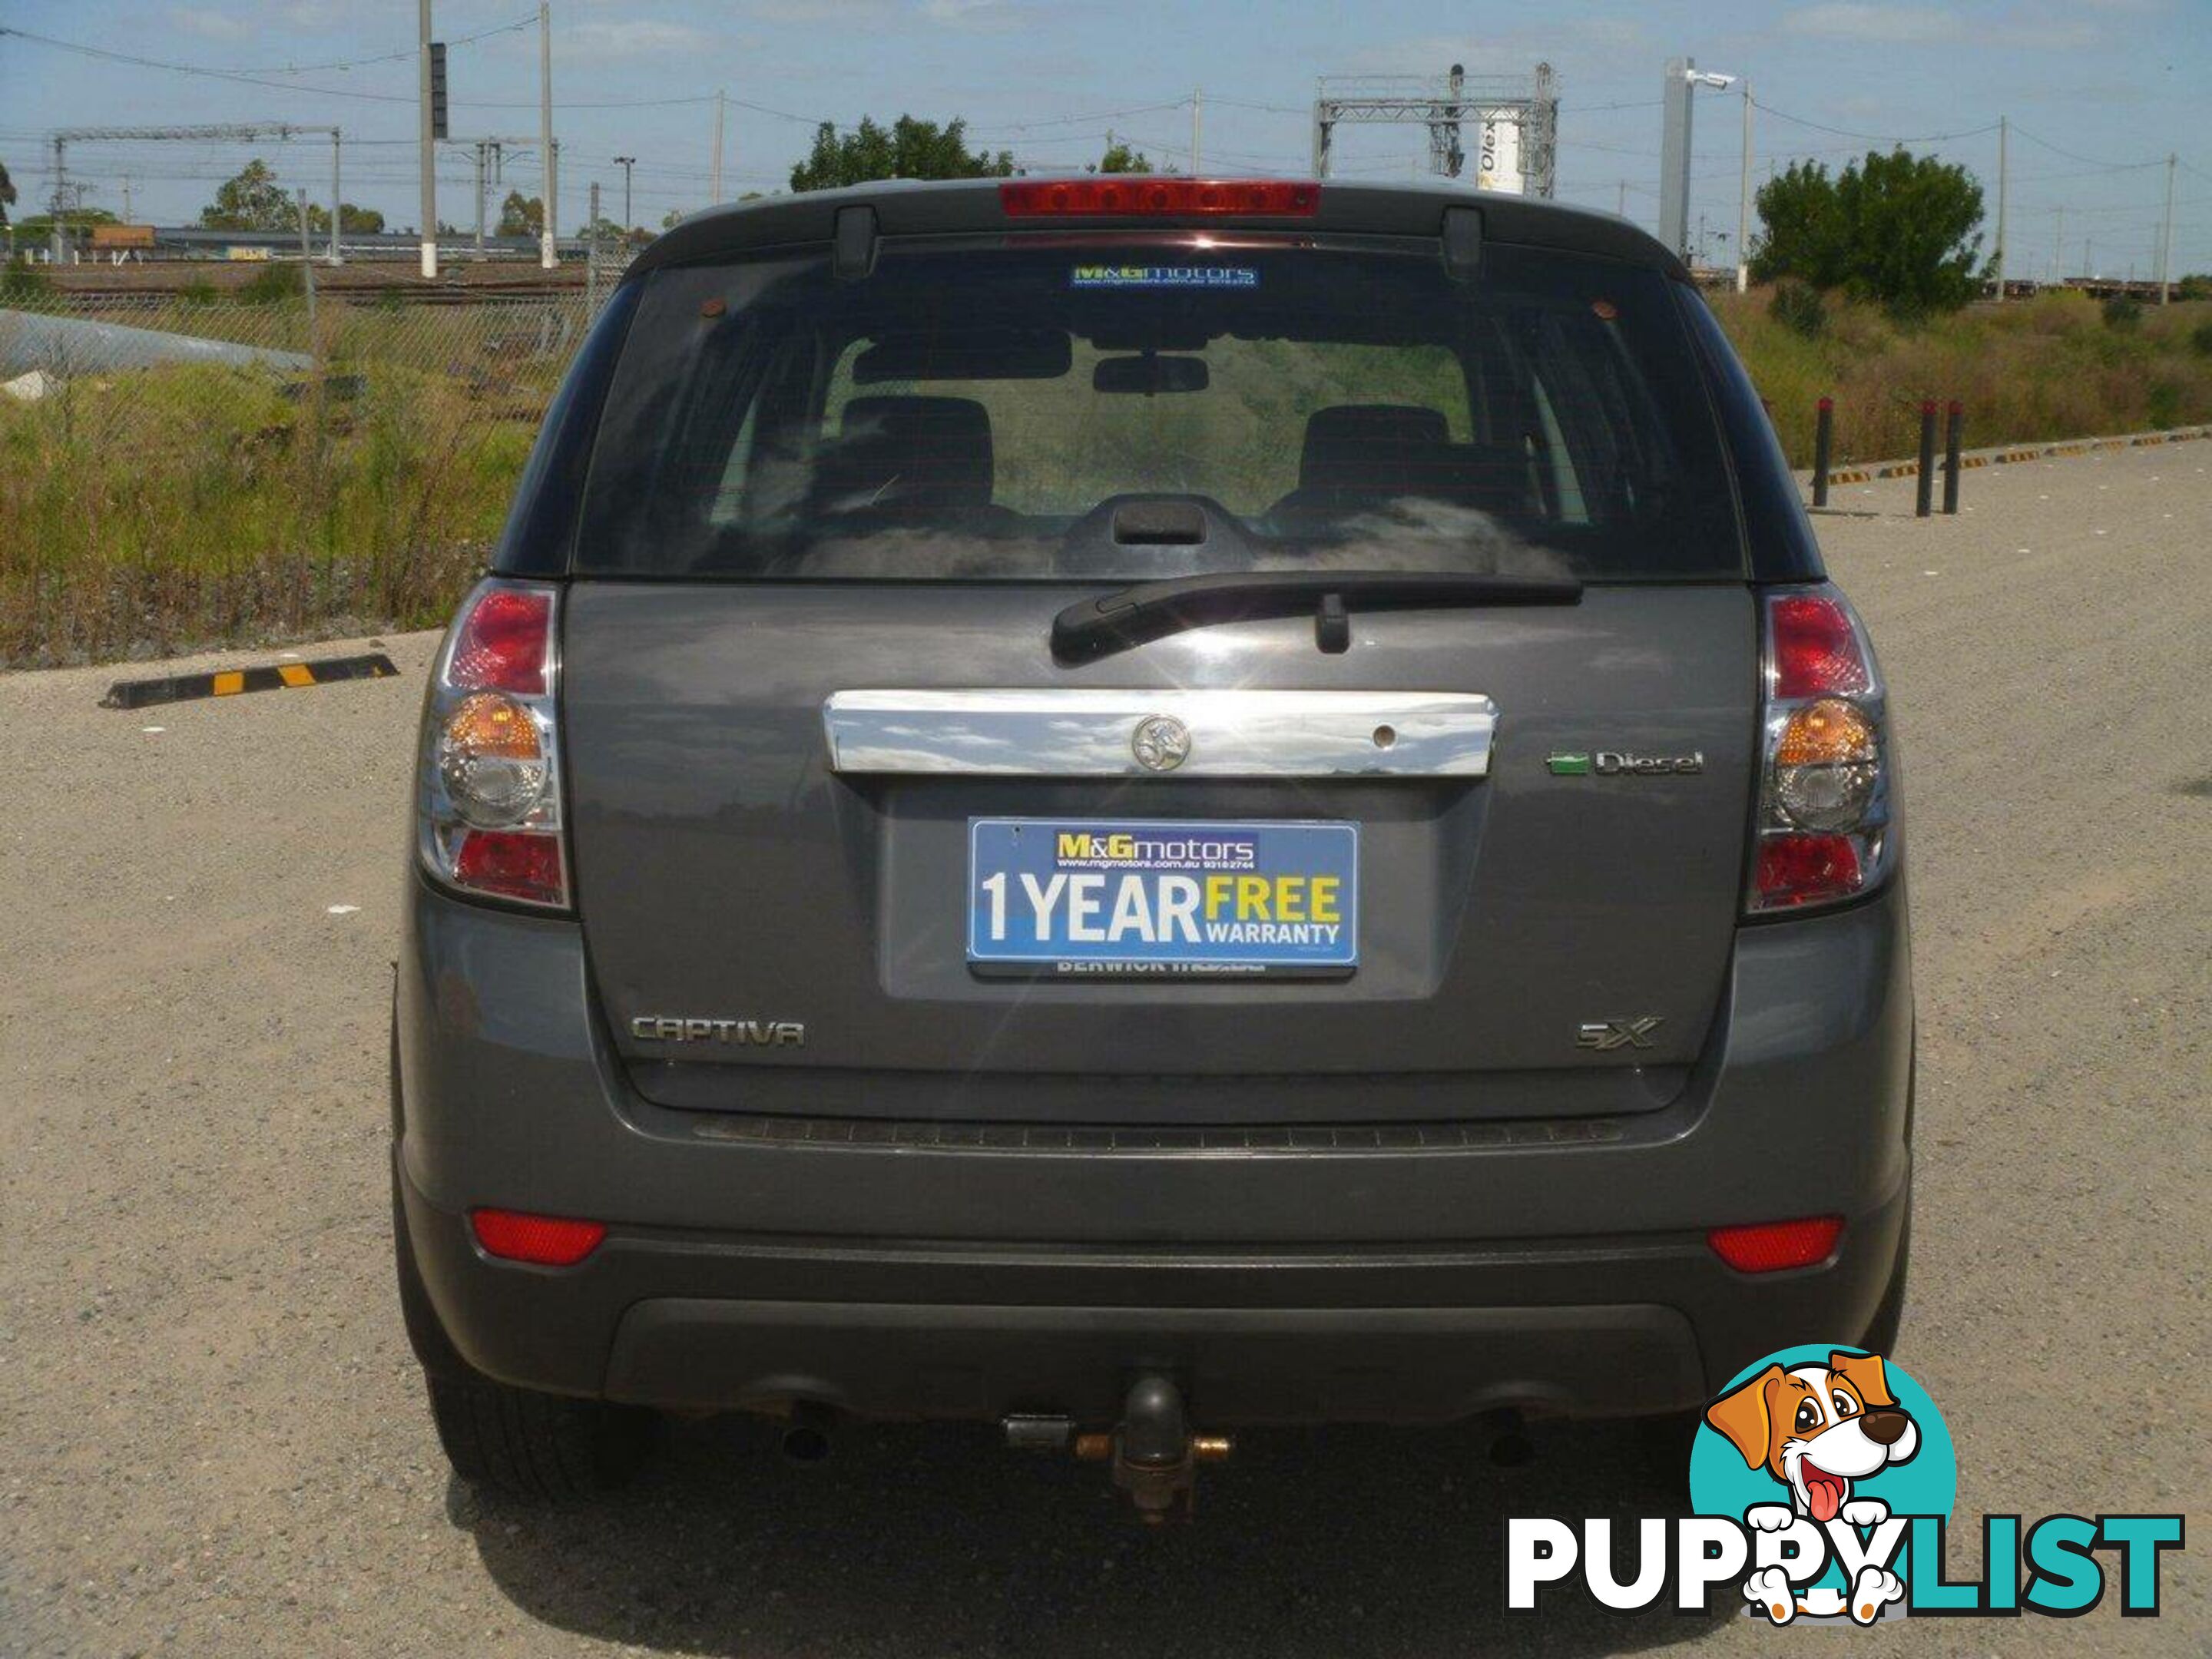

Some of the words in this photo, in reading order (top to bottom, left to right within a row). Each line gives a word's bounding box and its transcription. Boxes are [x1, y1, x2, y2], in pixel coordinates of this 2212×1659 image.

[1595, 750, 1703, 774] Diesel
[1058, 834, 1253, 859] M&Gmotors
[982, 873, 1006, 940] 1
[1021, 873, 1201, 942] YEAR
[1206, 877, 1340, 922] FREE
[1206, 924, 1340, 945] WARRANTY
[632, 1017, 805, 1046] CAPTIVA
